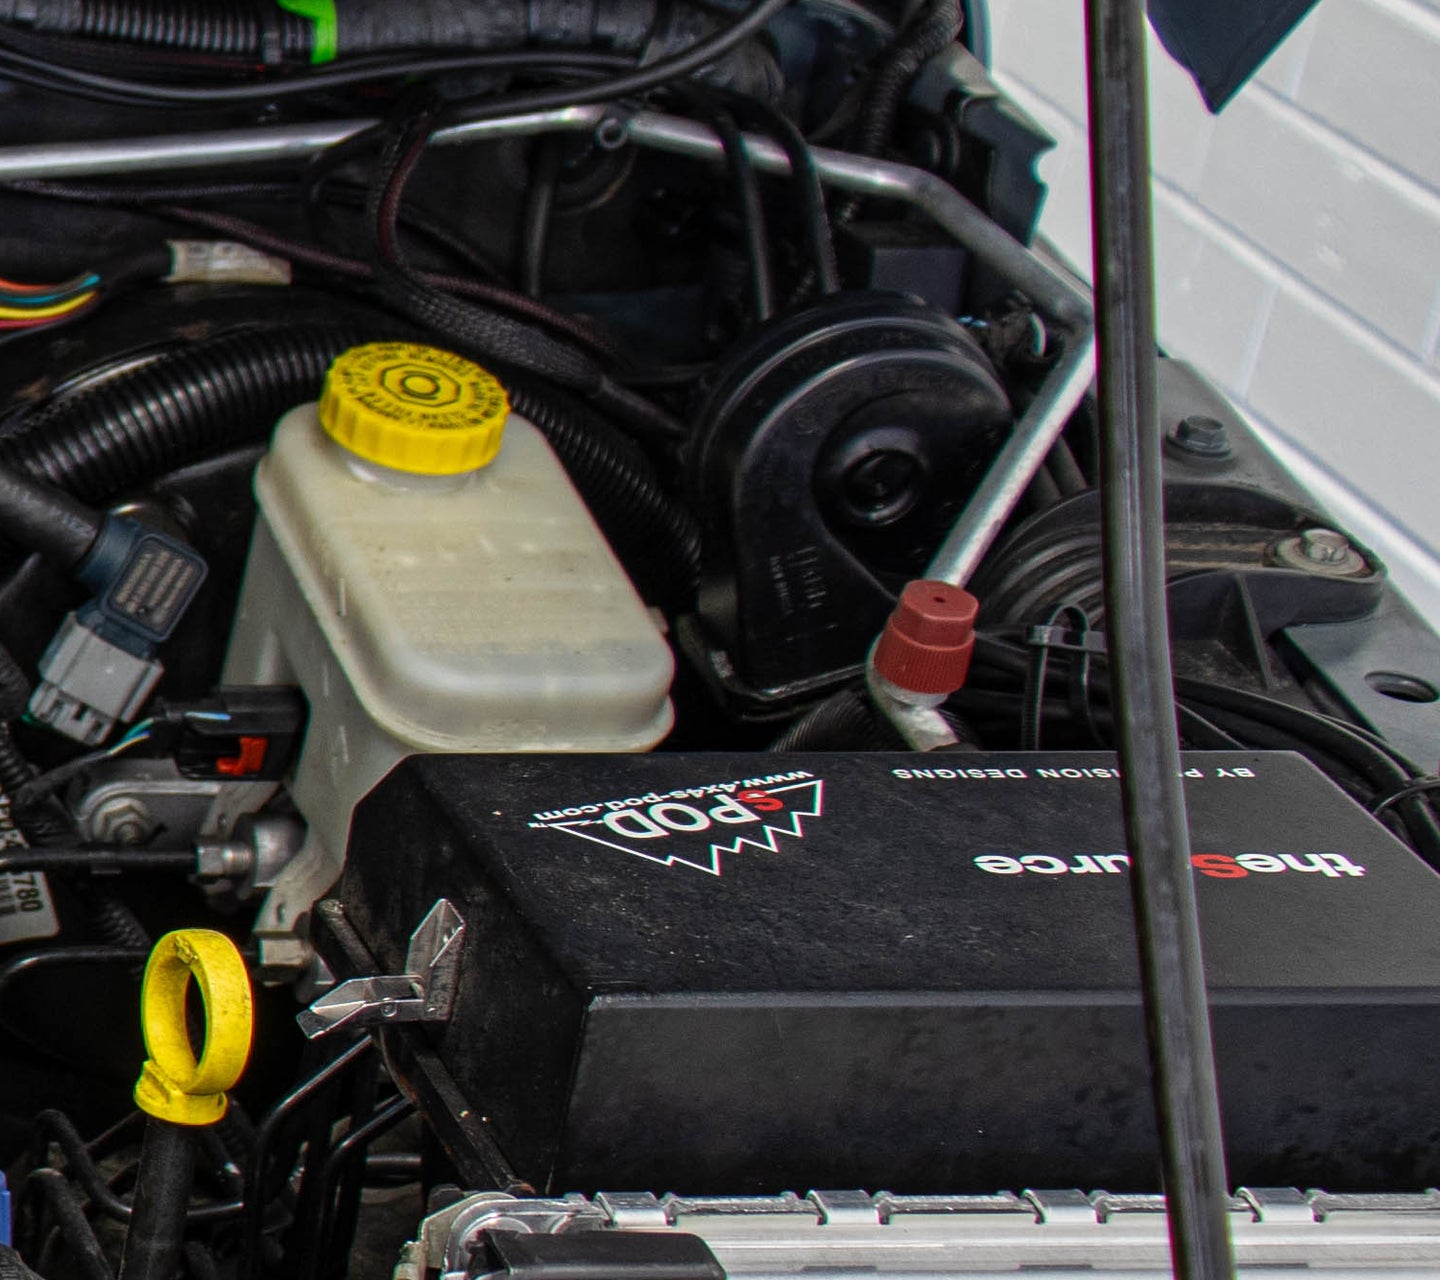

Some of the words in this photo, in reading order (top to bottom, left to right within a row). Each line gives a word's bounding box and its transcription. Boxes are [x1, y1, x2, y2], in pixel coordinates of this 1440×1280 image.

[891, 767, 1029, 780] DESIGNS
[1215, 767, 1256, 780] BY
[532, 770, 815, 823] www.4x4s-pod.com
[972, 851, 1366, 880] theSurce
